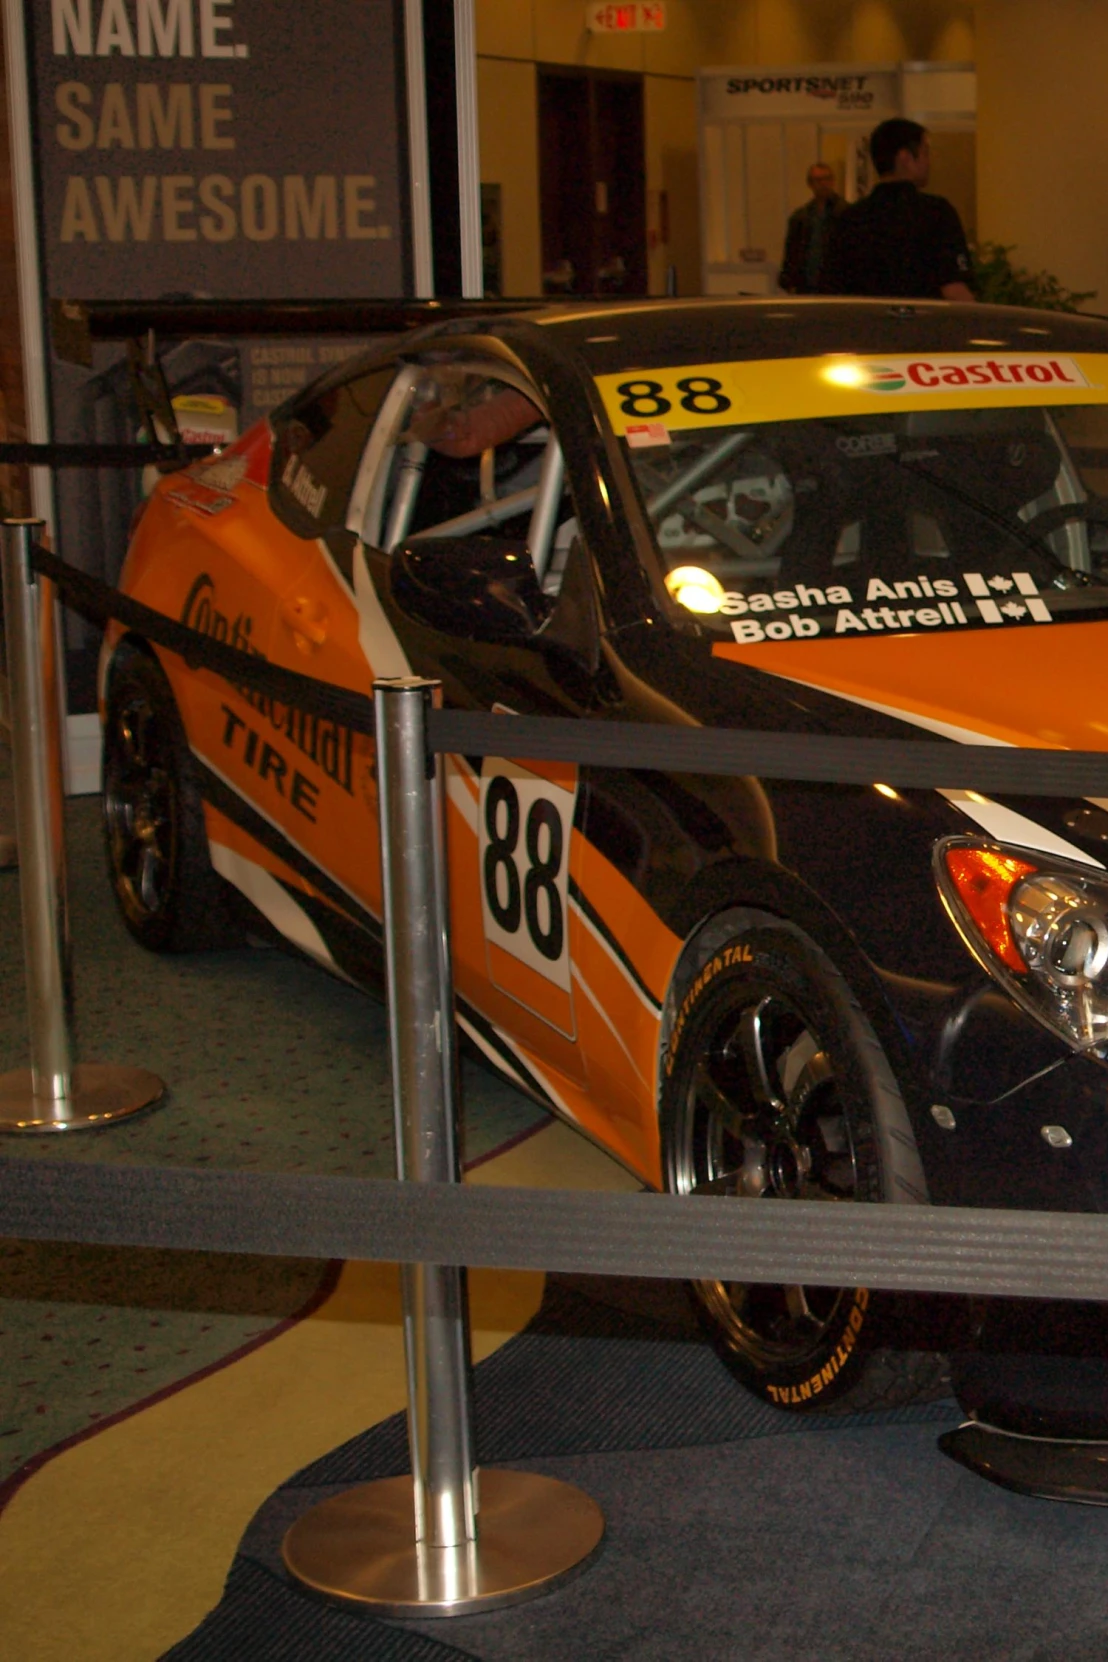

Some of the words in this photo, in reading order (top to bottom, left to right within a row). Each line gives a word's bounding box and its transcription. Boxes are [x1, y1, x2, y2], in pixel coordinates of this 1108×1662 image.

[52, 0, 248, 58] NAME.
[726, 76, 868, 95] SPORTSNET
[54, 80, 236, 150] SAME
[59, 173, 392, 242] AWESOME.
[615, 376, 732, 419] 88
[906, 360, 1076, 388] Castrol
[718, 584, 853, 617] Sasha
[865, 574, 960, 602] Anis
[729, 613, 821, 645] Bob
[834, 600, 968, 634] Attrell
[220, 701, 320, 825] TIRE
[484, 774, 564, 962] 88
